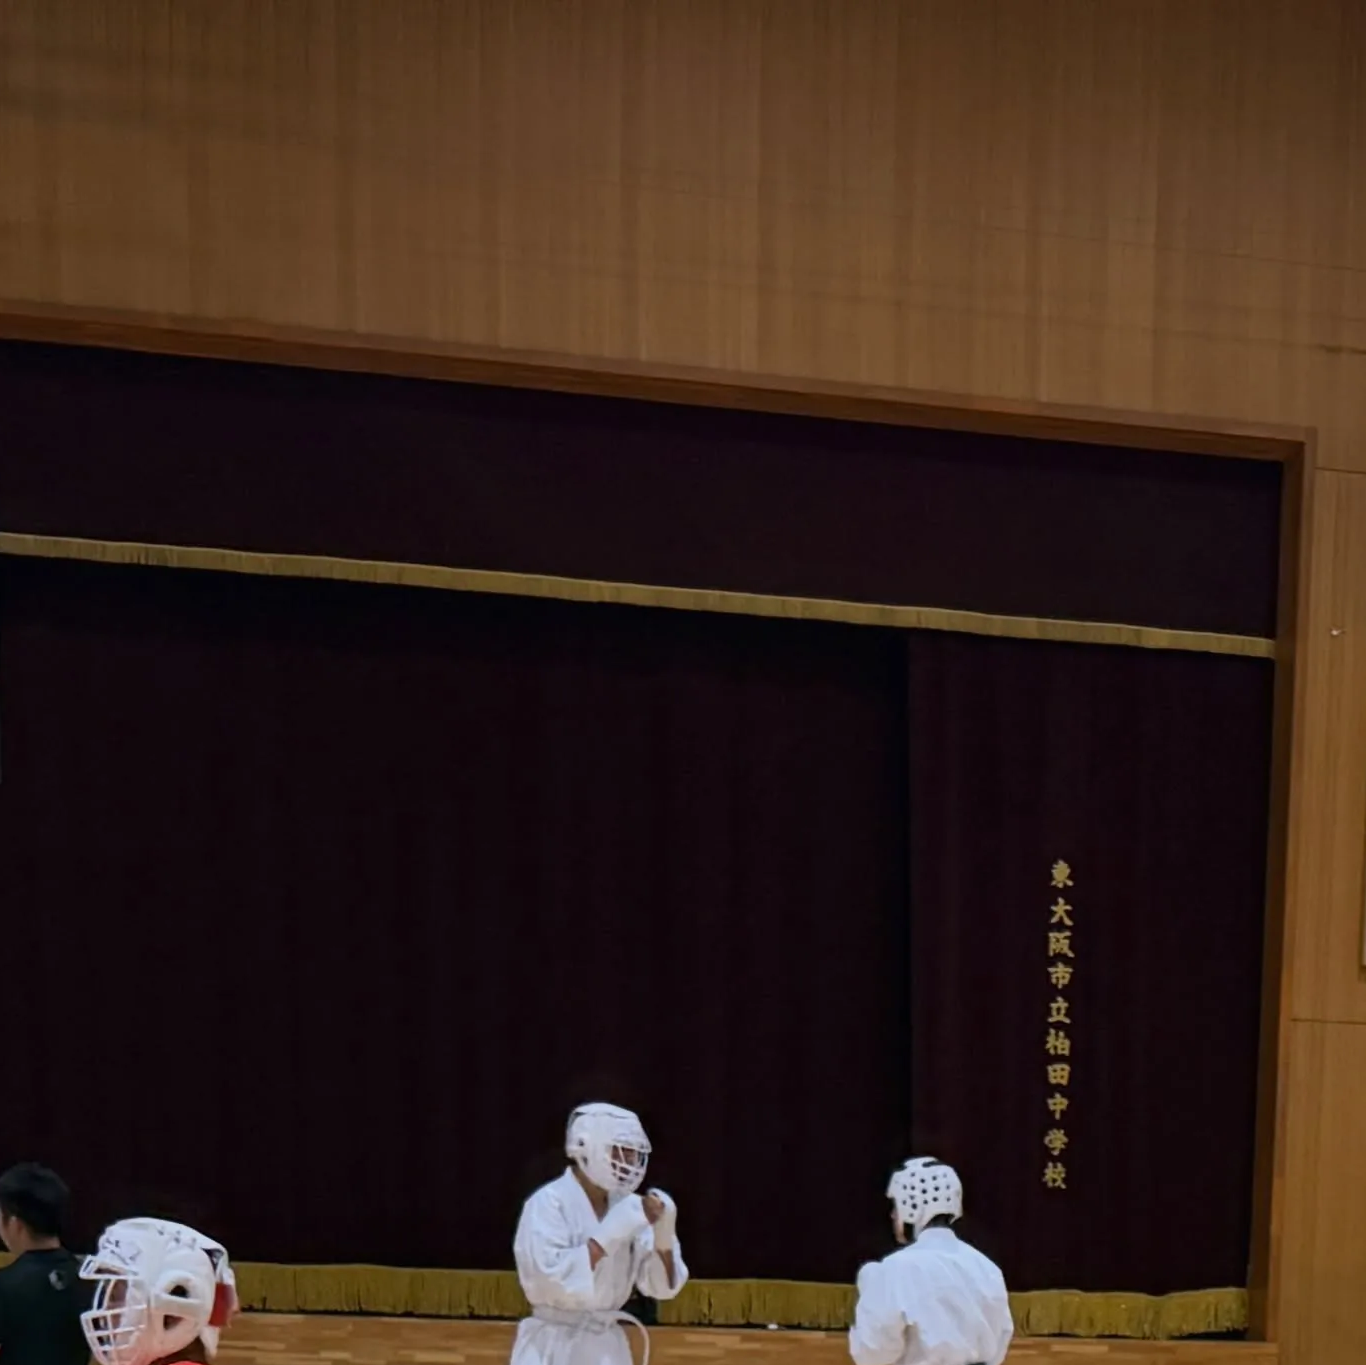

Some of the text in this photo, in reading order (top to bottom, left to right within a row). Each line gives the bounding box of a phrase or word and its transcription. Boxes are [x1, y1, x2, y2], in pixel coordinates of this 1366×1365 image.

[1043, 859, 1075, 1189] 東大阪市立柏田中学校
